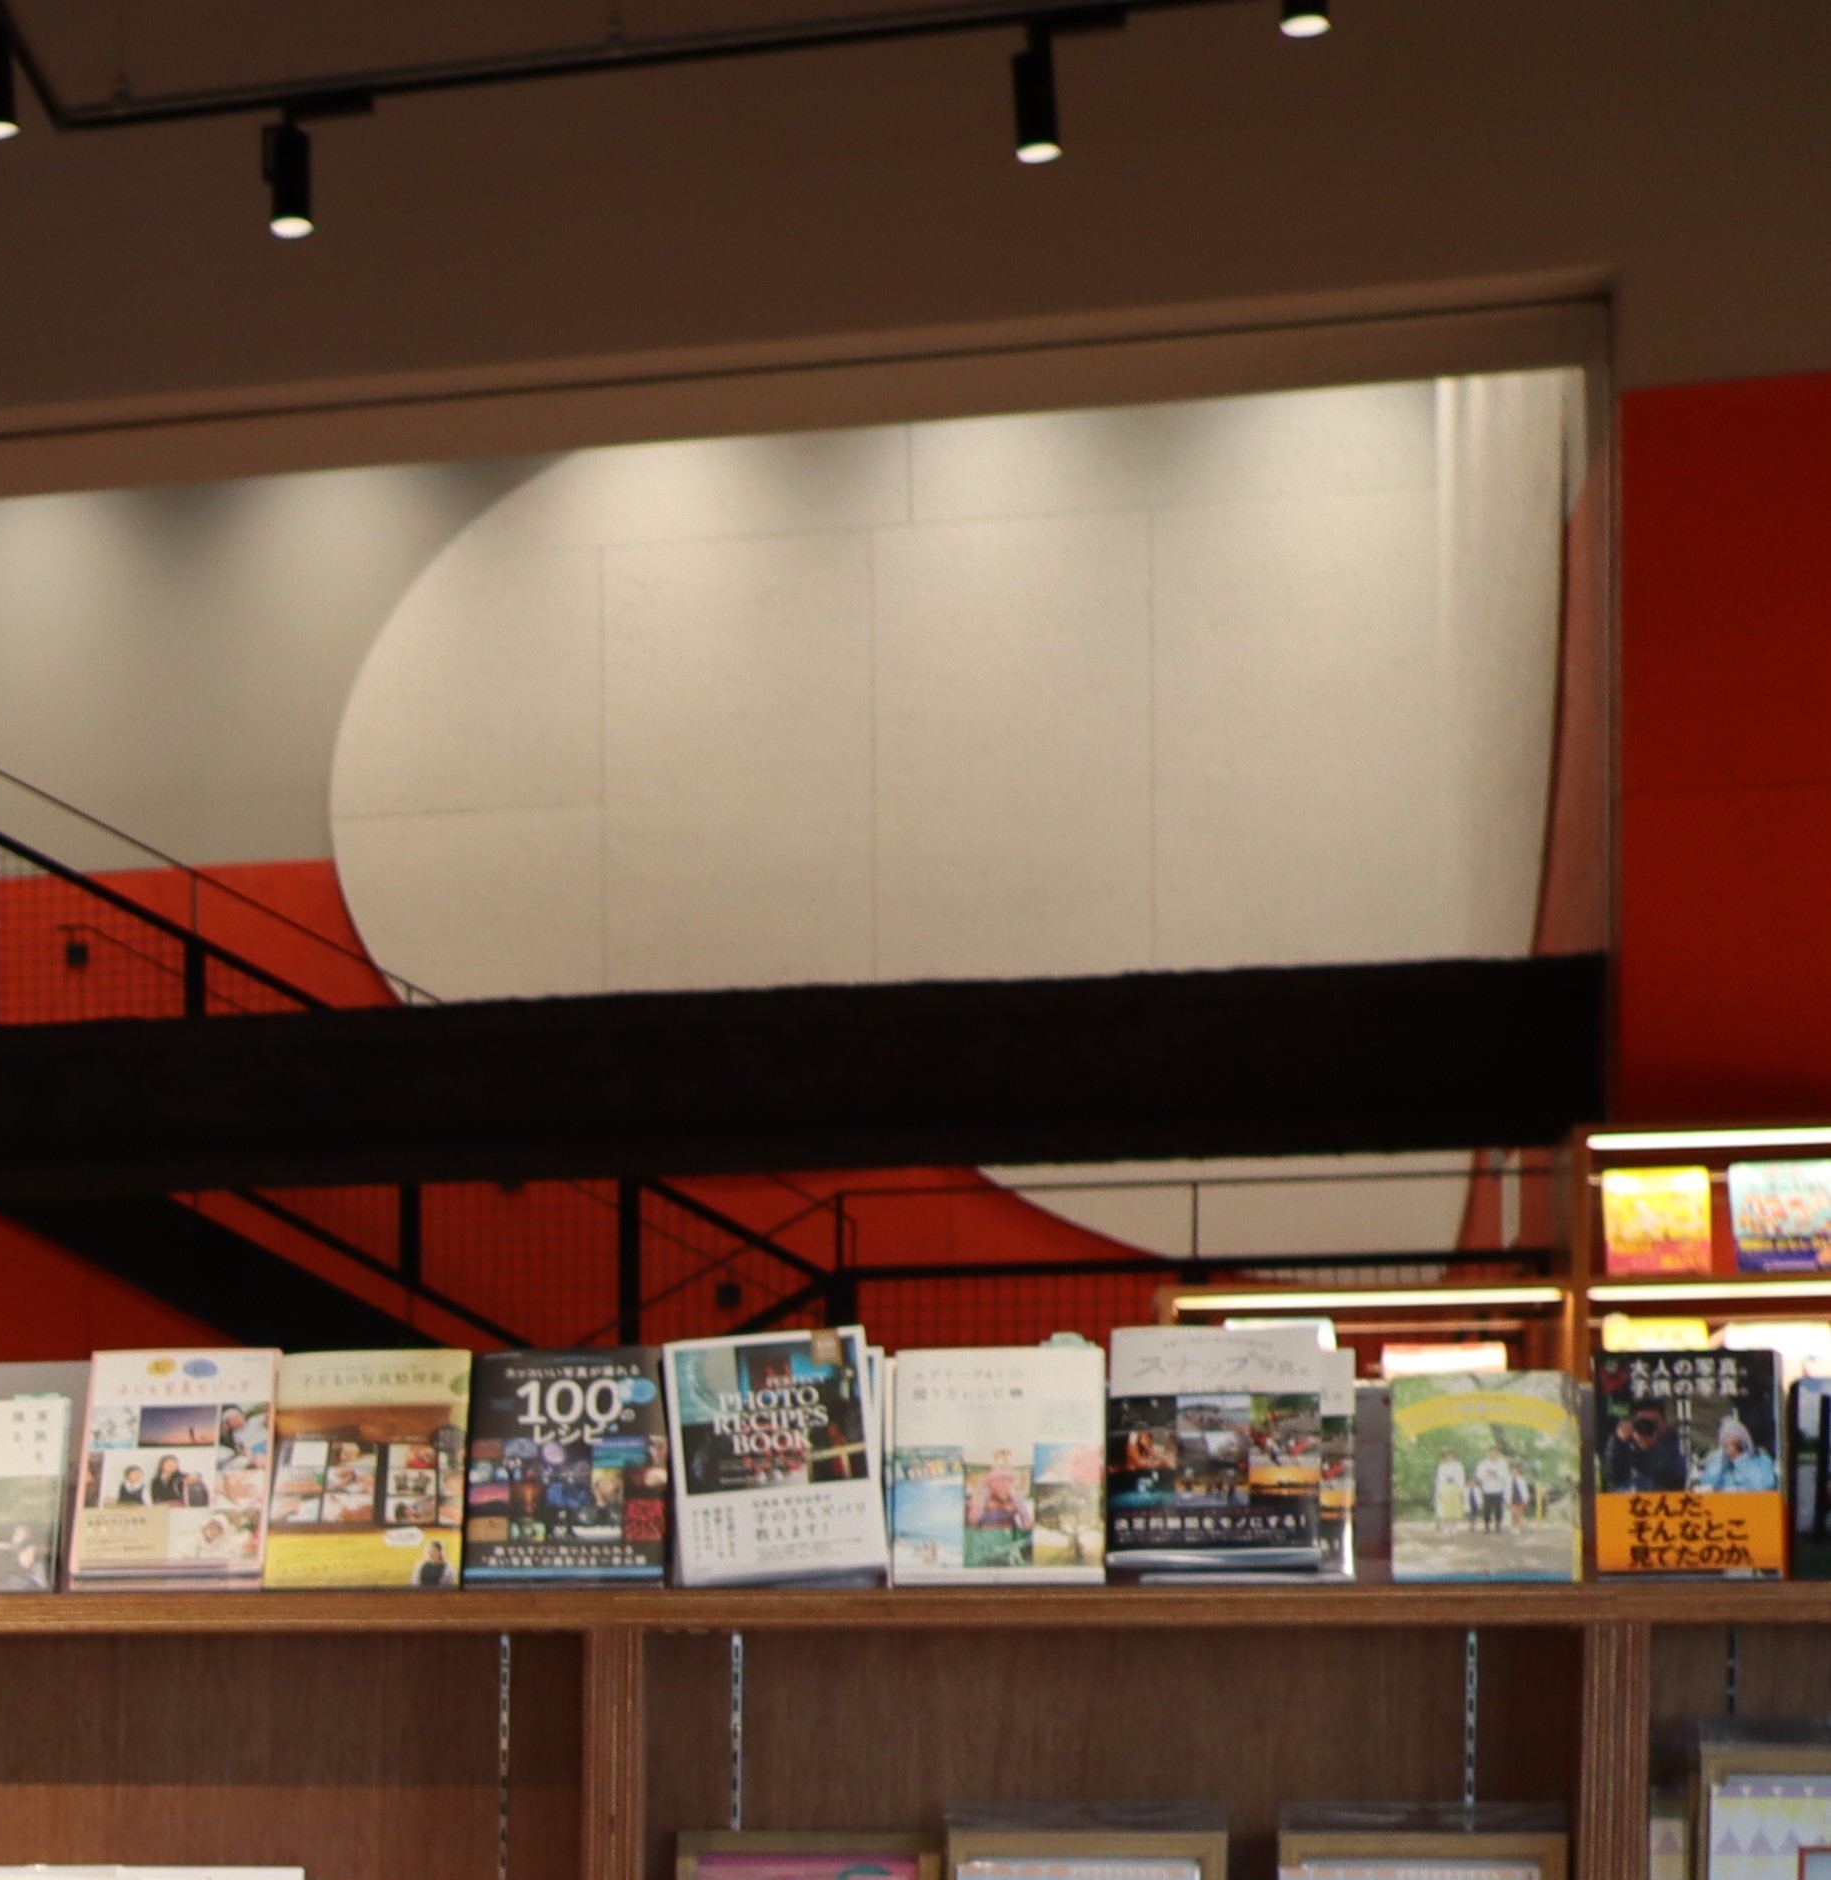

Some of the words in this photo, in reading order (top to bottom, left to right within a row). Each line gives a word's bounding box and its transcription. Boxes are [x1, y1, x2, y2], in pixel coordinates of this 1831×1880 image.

[718, 1386, 820, 1411] PHOTO
[713, 1404, 829, 1436] RECIPES
[732, 1428, 812, 1454] BOOK
[1629, 1518, 1750, 1543] そんなとこ
